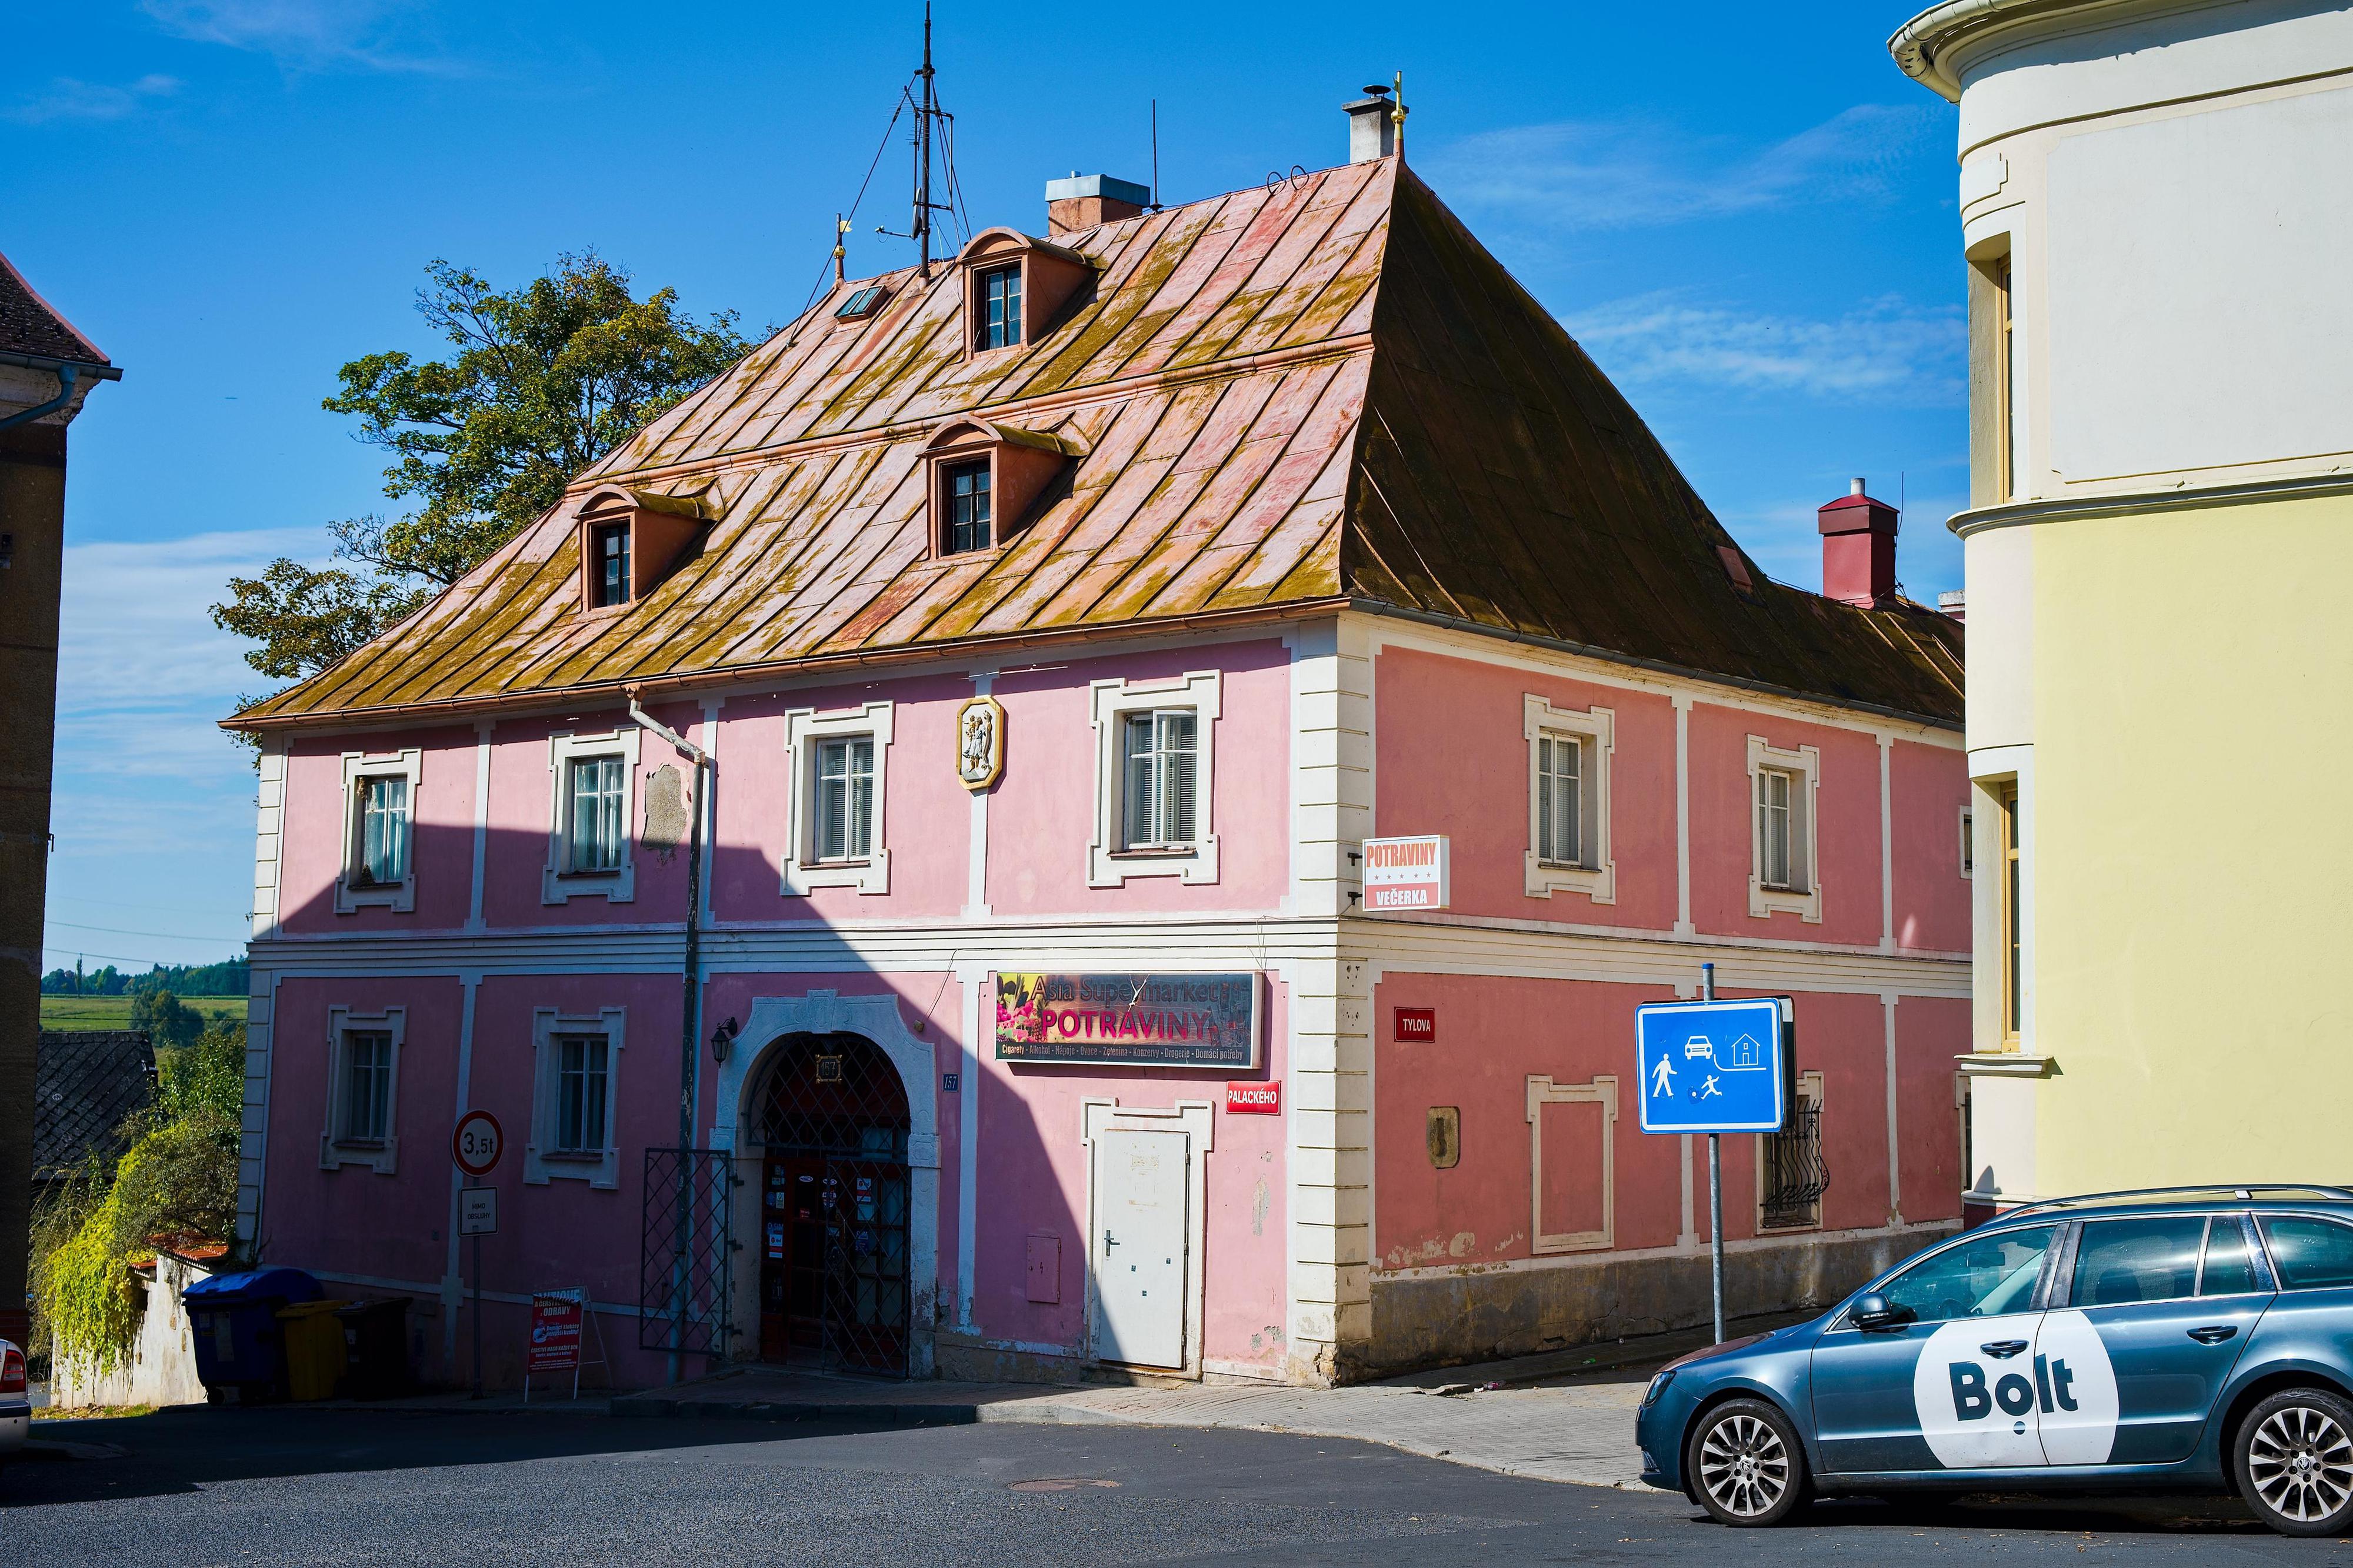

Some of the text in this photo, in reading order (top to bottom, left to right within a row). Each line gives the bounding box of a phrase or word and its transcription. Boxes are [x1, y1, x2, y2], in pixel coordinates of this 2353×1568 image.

[1367, 843, 1437, 868] POTRAVINY
[1376, 888, 1428, 906] VEČERKA
[1031, 976, 1074, 1001] Asia
[1042, 1009, 1209, 1040] POTRAVINY
[1402, 1019, 1431, 1032] TYLOVA
[1002, 1045, 1025, 1055] Cigarety
[1029, 1045, 1050, 1055] Alkohol
[1055, 1045, 1075, 1056] Nápoje
[1080, 1046, 1098, 1055] Ovoce
[1133, 1047, 1159, 1058] Konzervy
[1165, 1048, 1189, 1058] Drogerie
[1195, 1048, 1218, 1059] Domácí
[1219, 1049, 1243, 1061] potřeby
[944, 1076, 957, 1089] 157
[1228, 1090, 1277, 1105] PALACKÉHO
[464, 1132, 493, 1156] 3,5t
[544, 1307, 571, 1316] ODRAVY
[1949, 1353, 2078, 1421] Bolt
